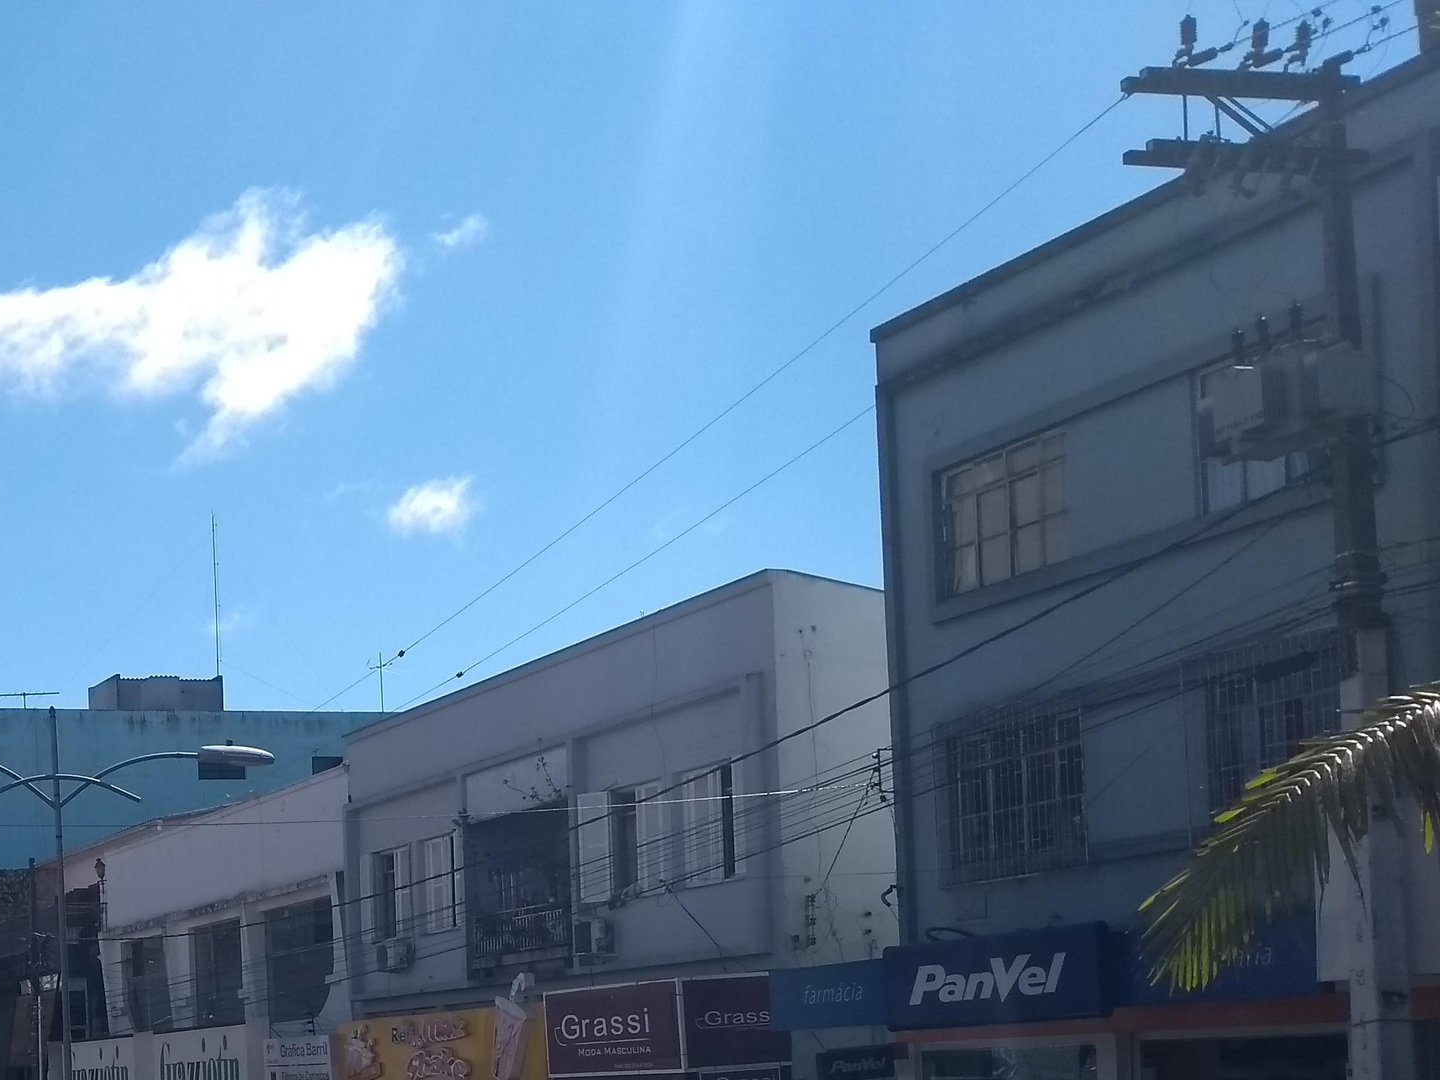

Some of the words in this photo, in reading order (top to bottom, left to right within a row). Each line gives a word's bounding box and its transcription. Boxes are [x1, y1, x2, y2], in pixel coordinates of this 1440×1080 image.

[909, 952, 1066, 1005] PanVel
[803, 982, 863, 1006] farmácia
[561, 1008, 651, 1040] Grassi
[704, 1010, 770, 1026] Grass
[830, 1056, 887, 1074] PanVel
